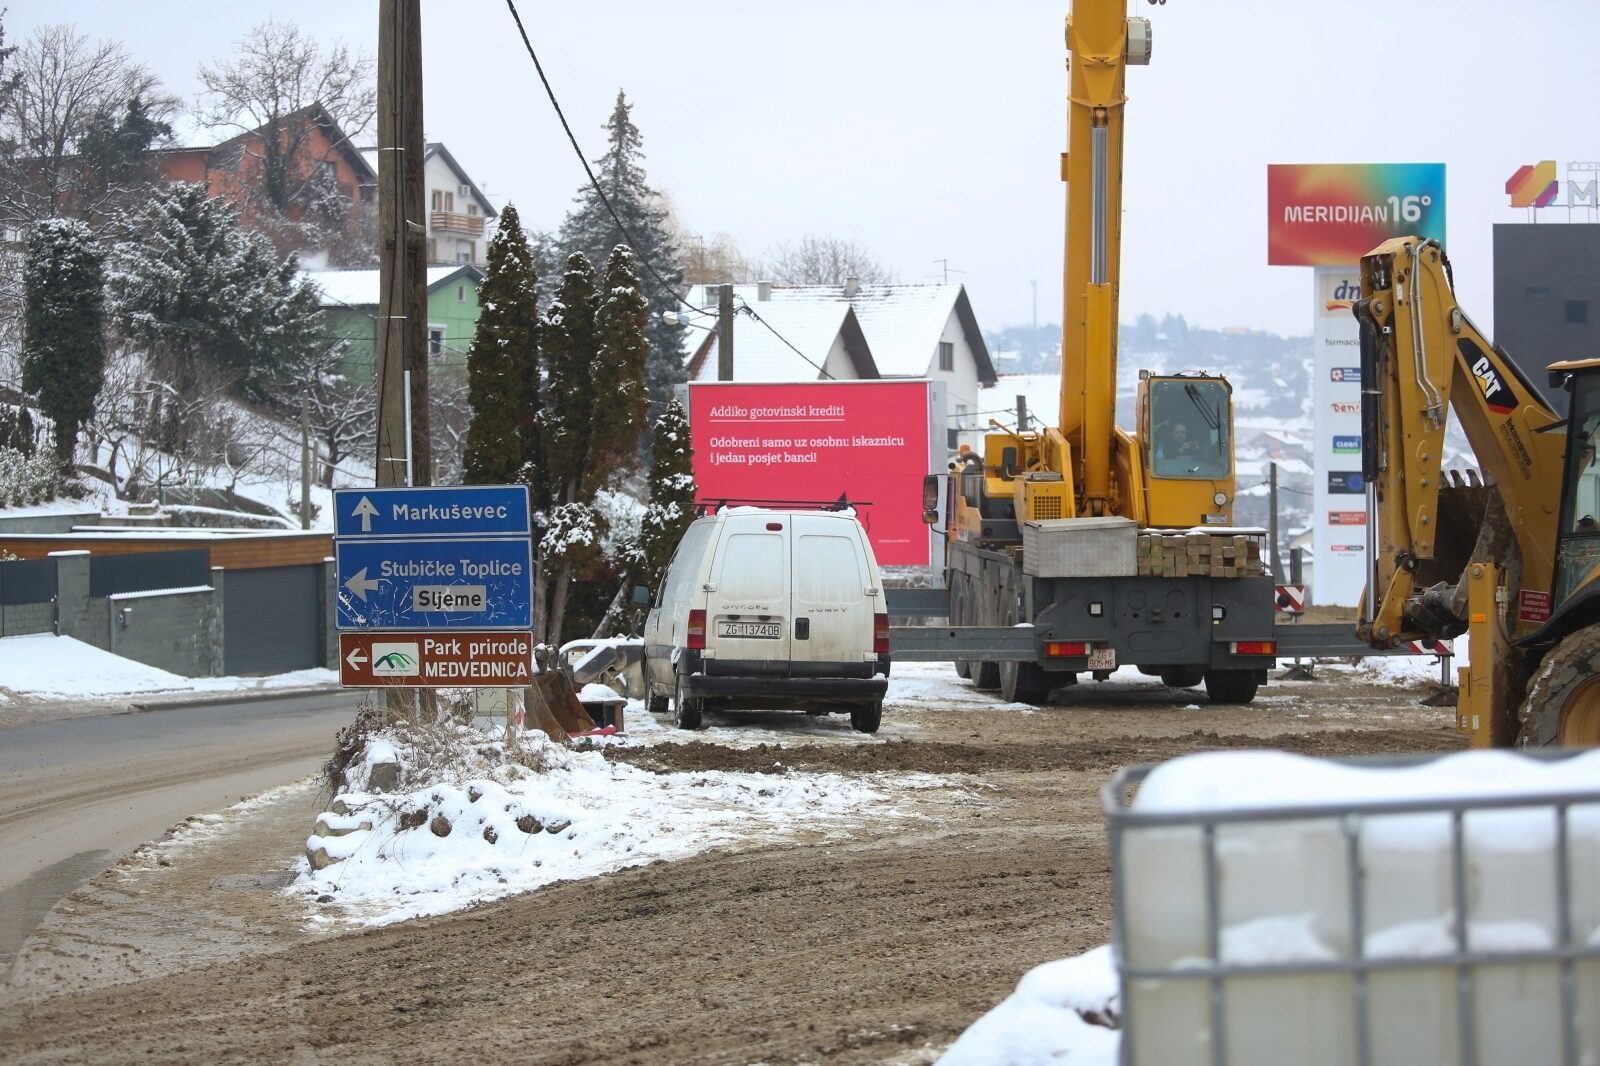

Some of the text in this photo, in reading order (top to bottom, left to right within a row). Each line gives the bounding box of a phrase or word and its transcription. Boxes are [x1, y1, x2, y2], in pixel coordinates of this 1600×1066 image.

[1284, 206, 1388, 223] MERIDIJAN
[1472, 356, 1502, 399] CAT
[710, 405, 845, 420] Addiko gotovinski krediti
[710, 435, 905, 448] Odobreni samo uz osobnu iskaznicu
[710, 452, 817, 465] i jedan posjet banci!
[392, 504, 508, 521] Markuševec
[380, 560, 522, 579] Stubičke Toplice
[418, 591, 482, 610] Sljeme
[725, 624, 738, 635] ZG
[424, 639, 528, 658] Park prirode
[425, 662, 528, 677] MEDVEDNICA
